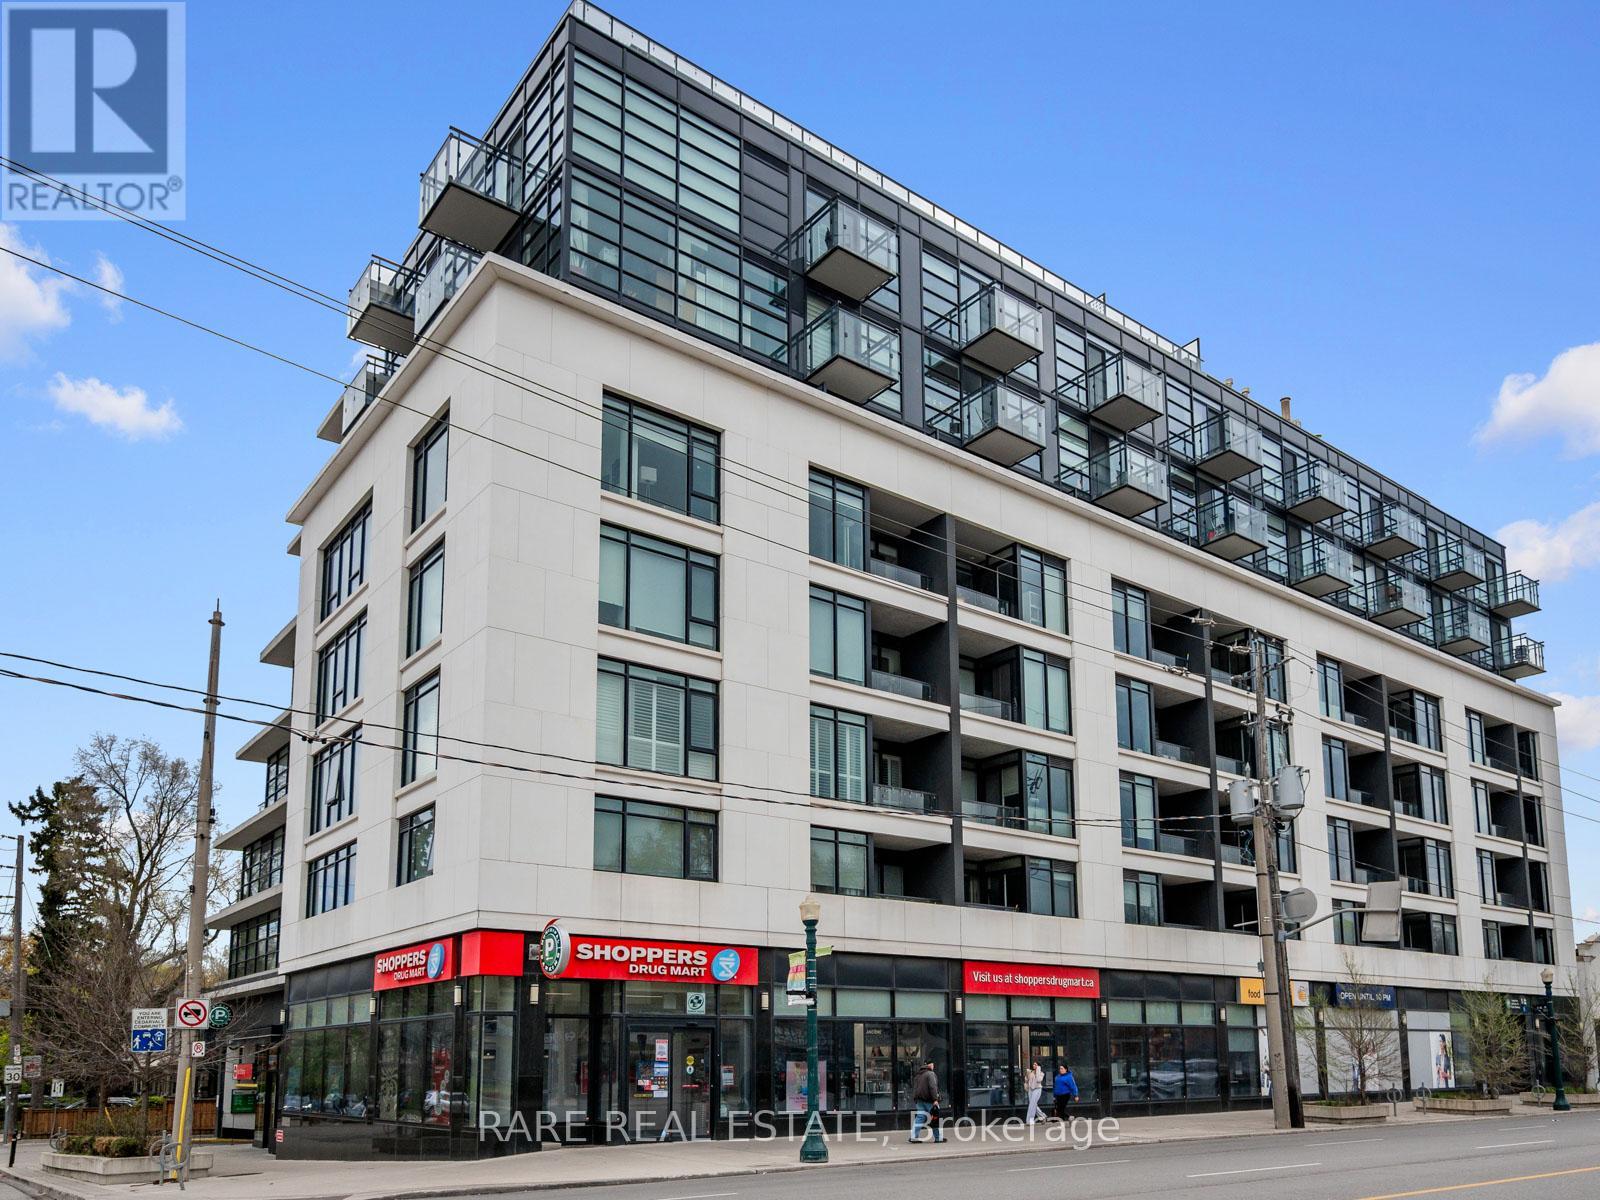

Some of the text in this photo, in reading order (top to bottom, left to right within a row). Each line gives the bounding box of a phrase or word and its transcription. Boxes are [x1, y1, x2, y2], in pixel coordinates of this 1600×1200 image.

[376, 949, 427, 974] SHOPPERS
[576, 942, 708, 966] SHOPPERS
[393, 966, 426, 981] DRUG MART
[629, 963, 708, 978] DRUG MART
[972, 971, 1095, 989] Visit us at shoppersdrugmart.ca
[1247, 988, 1261, 999] food
[1340, 991, 1357, 1000] OPEN
[1382, 993, 1392, 1002] PM
[6, 1072, 20, 1081] 30
